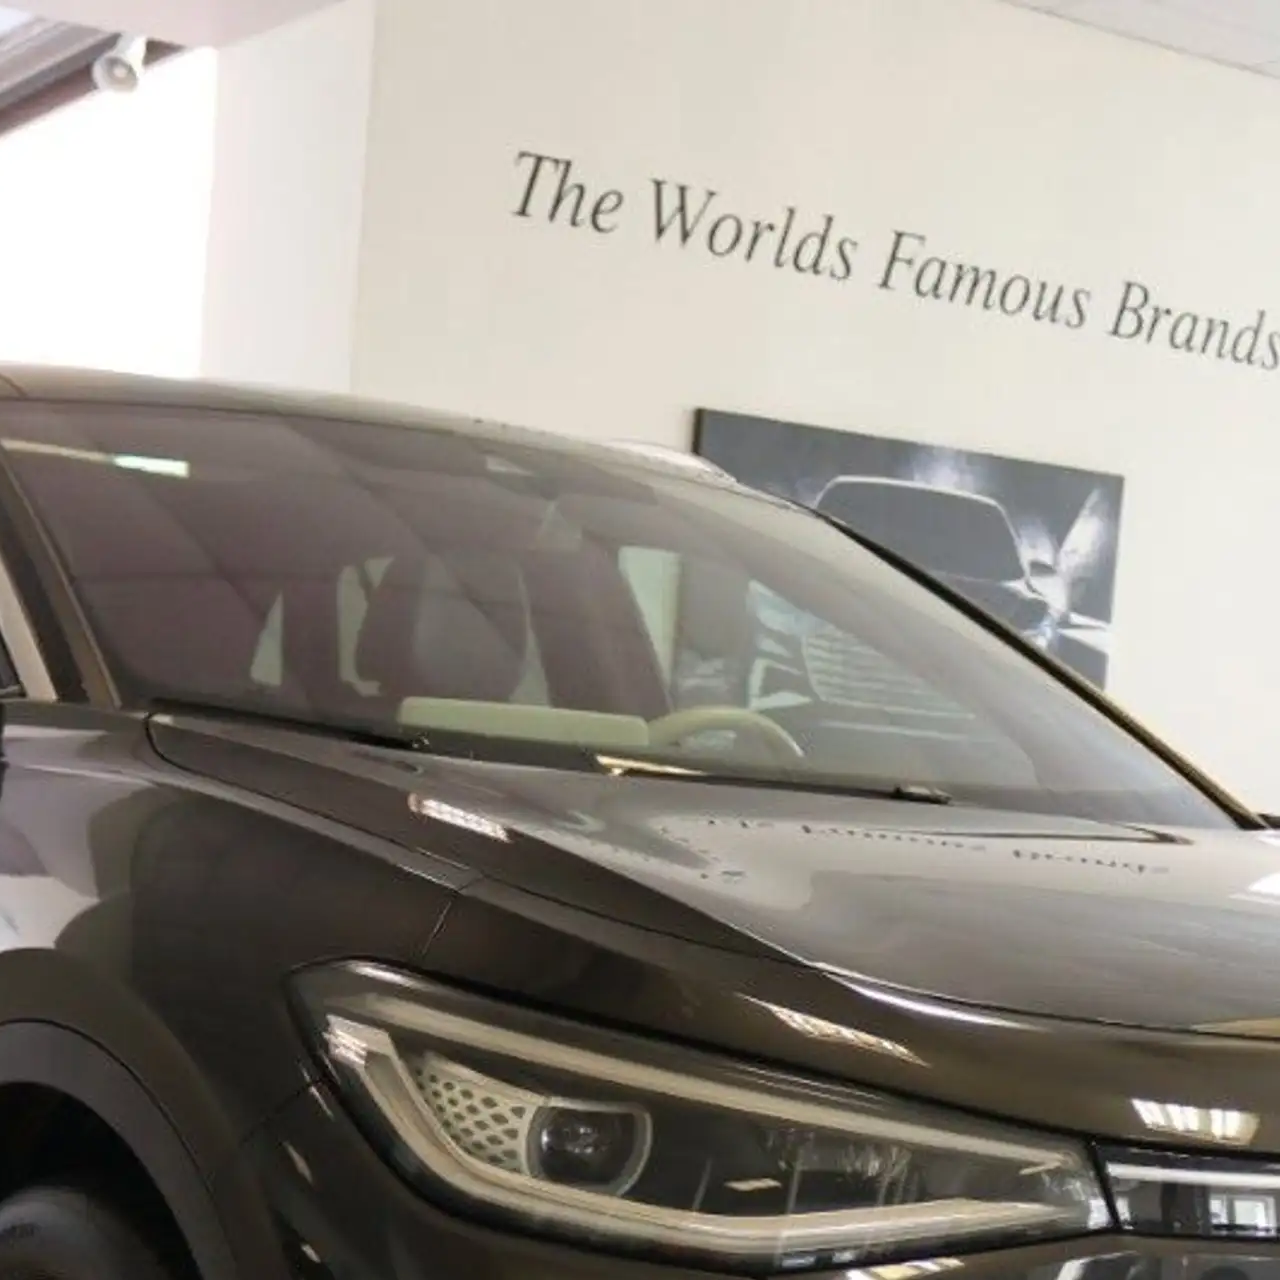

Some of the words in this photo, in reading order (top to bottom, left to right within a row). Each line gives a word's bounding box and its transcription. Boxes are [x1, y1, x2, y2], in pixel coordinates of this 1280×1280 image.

[511, 150, 625, 235] The
[649, 177, 859, 283] Worlds
[876, 229, 1092, 330] Famous
